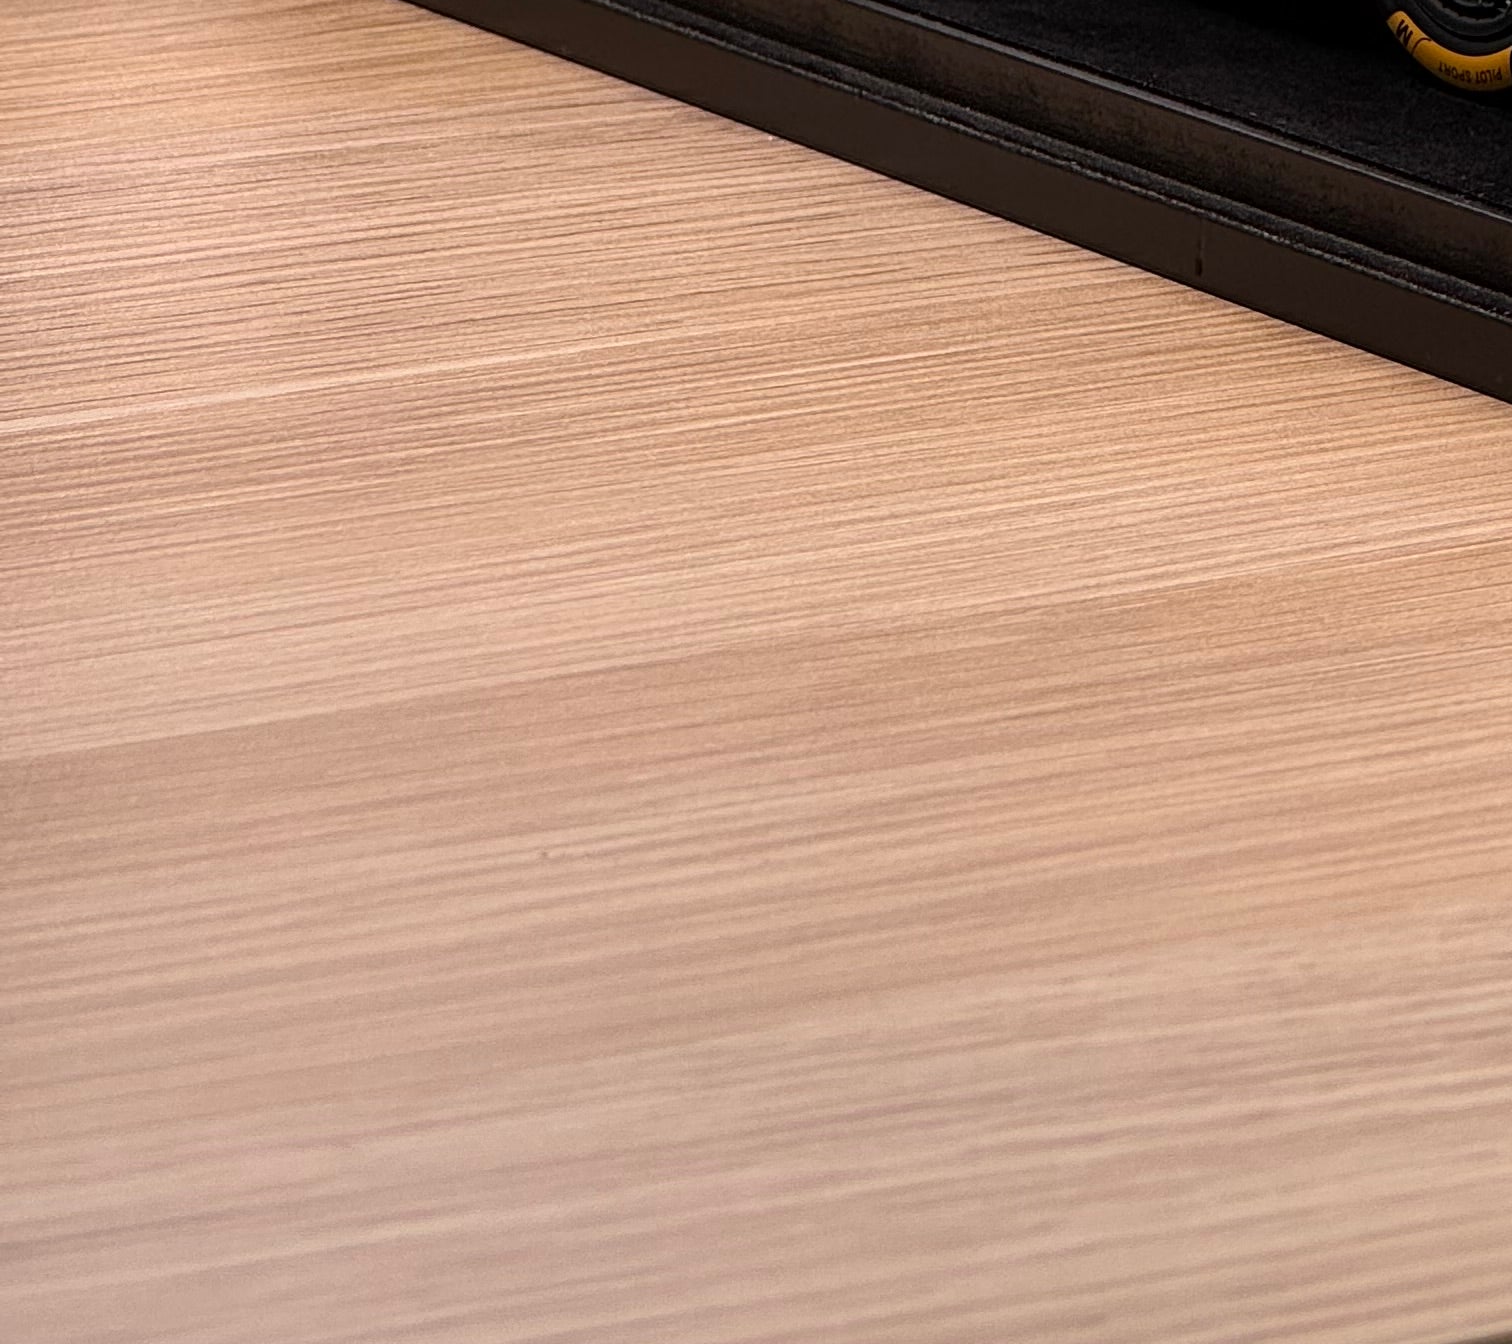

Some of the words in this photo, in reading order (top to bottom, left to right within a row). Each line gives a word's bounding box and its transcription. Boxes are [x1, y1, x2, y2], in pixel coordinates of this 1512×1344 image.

[1398, 19, 1413, 50] M
[1438, 60, 1472, 83] SPORT
[1475, 69, 1503, 84] PILOT
